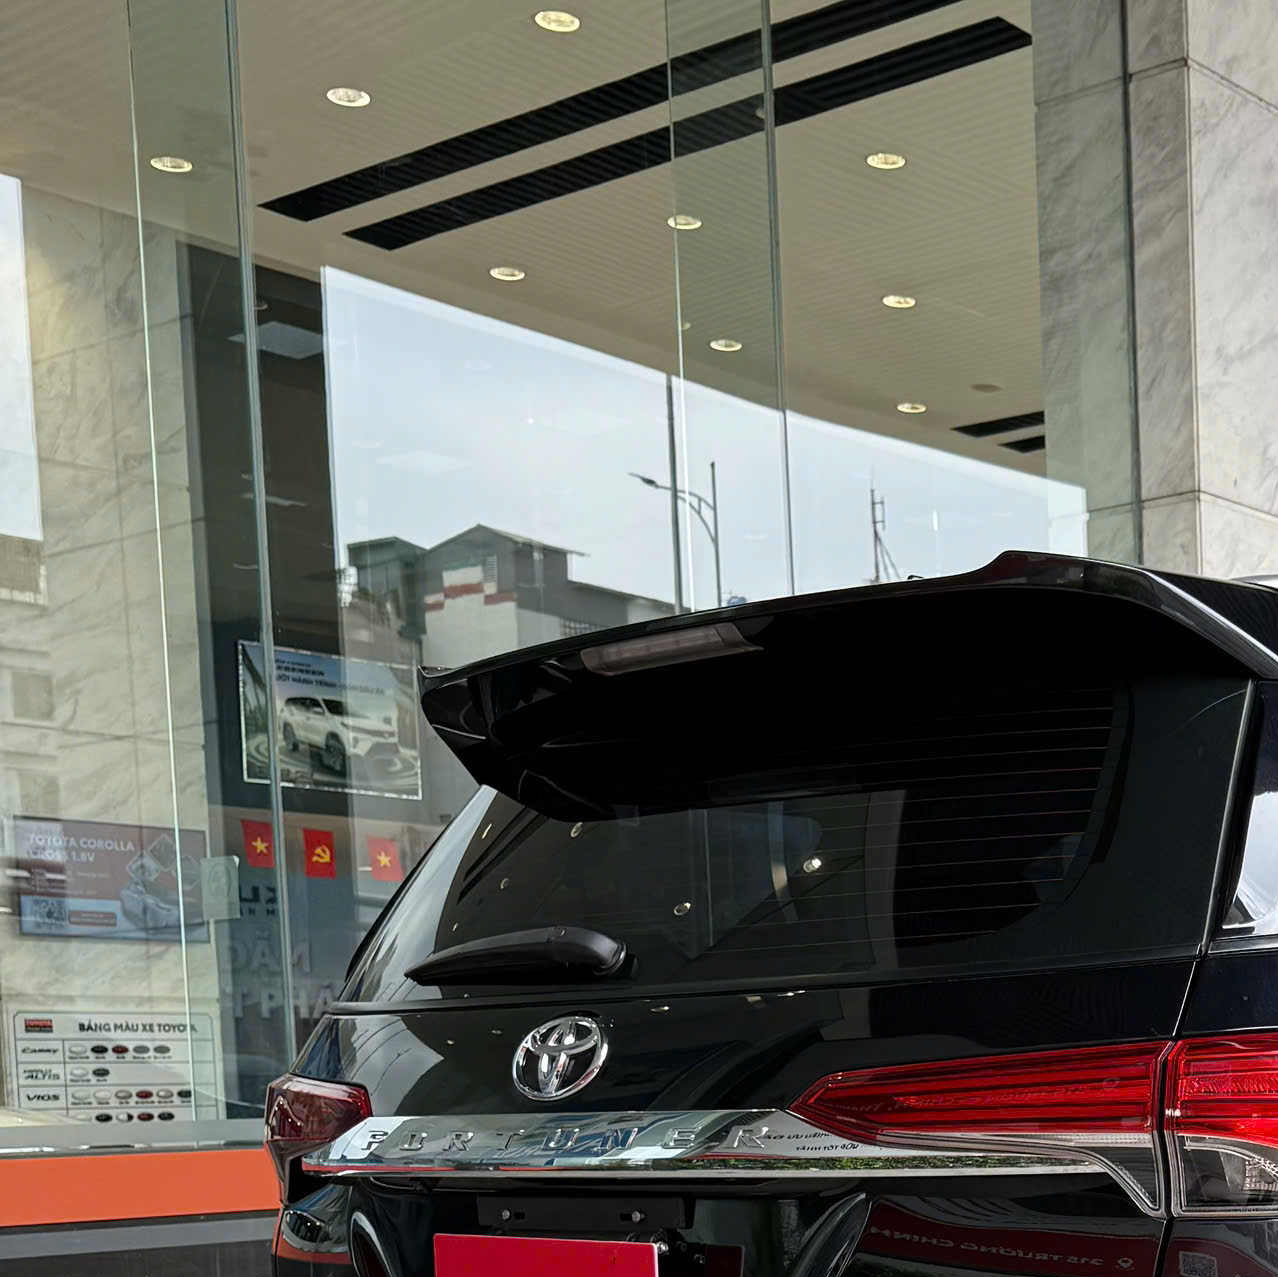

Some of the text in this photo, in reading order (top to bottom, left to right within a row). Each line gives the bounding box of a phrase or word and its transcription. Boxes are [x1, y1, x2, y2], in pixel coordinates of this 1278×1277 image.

[29, 833, 135, 851] TOYOTA COROLLA
[141, 1022, 155, 1033] XE
[26, 1093, 60, 1102] VIOS
[360, 1125, 769, 1152] FORTUNER
